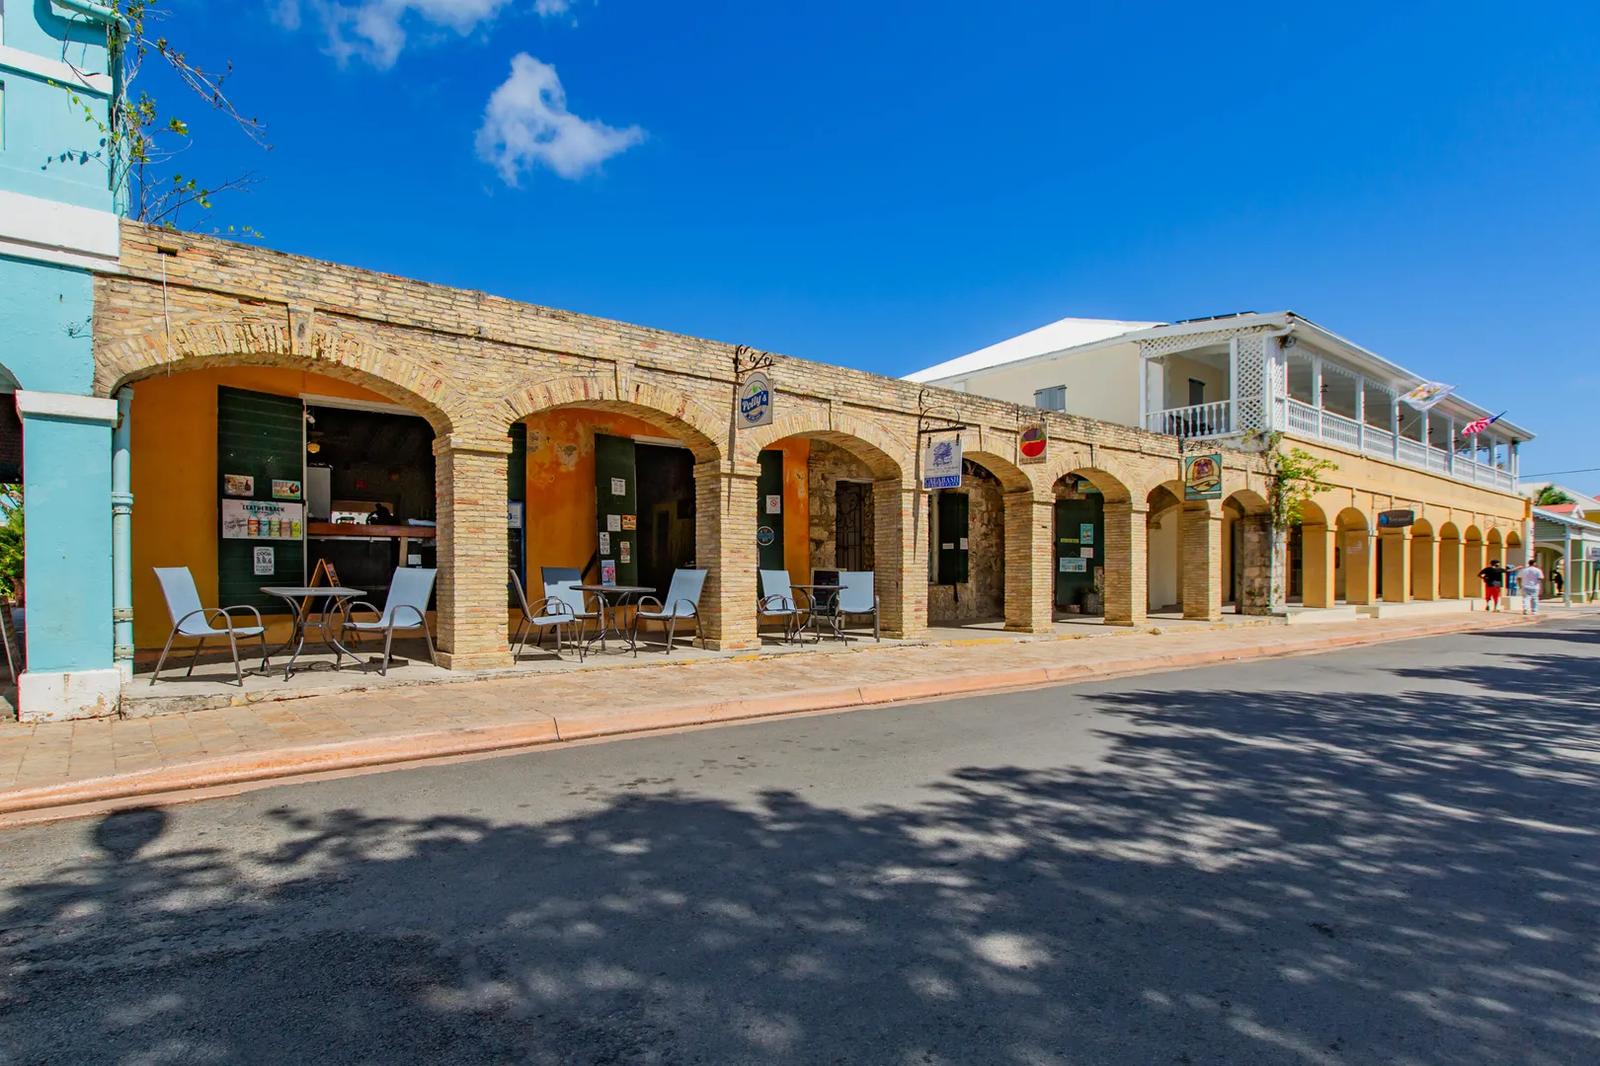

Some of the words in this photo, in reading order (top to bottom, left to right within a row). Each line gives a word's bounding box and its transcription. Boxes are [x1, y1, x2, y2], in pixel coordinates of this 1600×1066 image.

[742, 391, 768, 411] Polly's
[925, 475, 960, 484] CALABASH
[242, 504, 285, 512] LEATHERBACK
